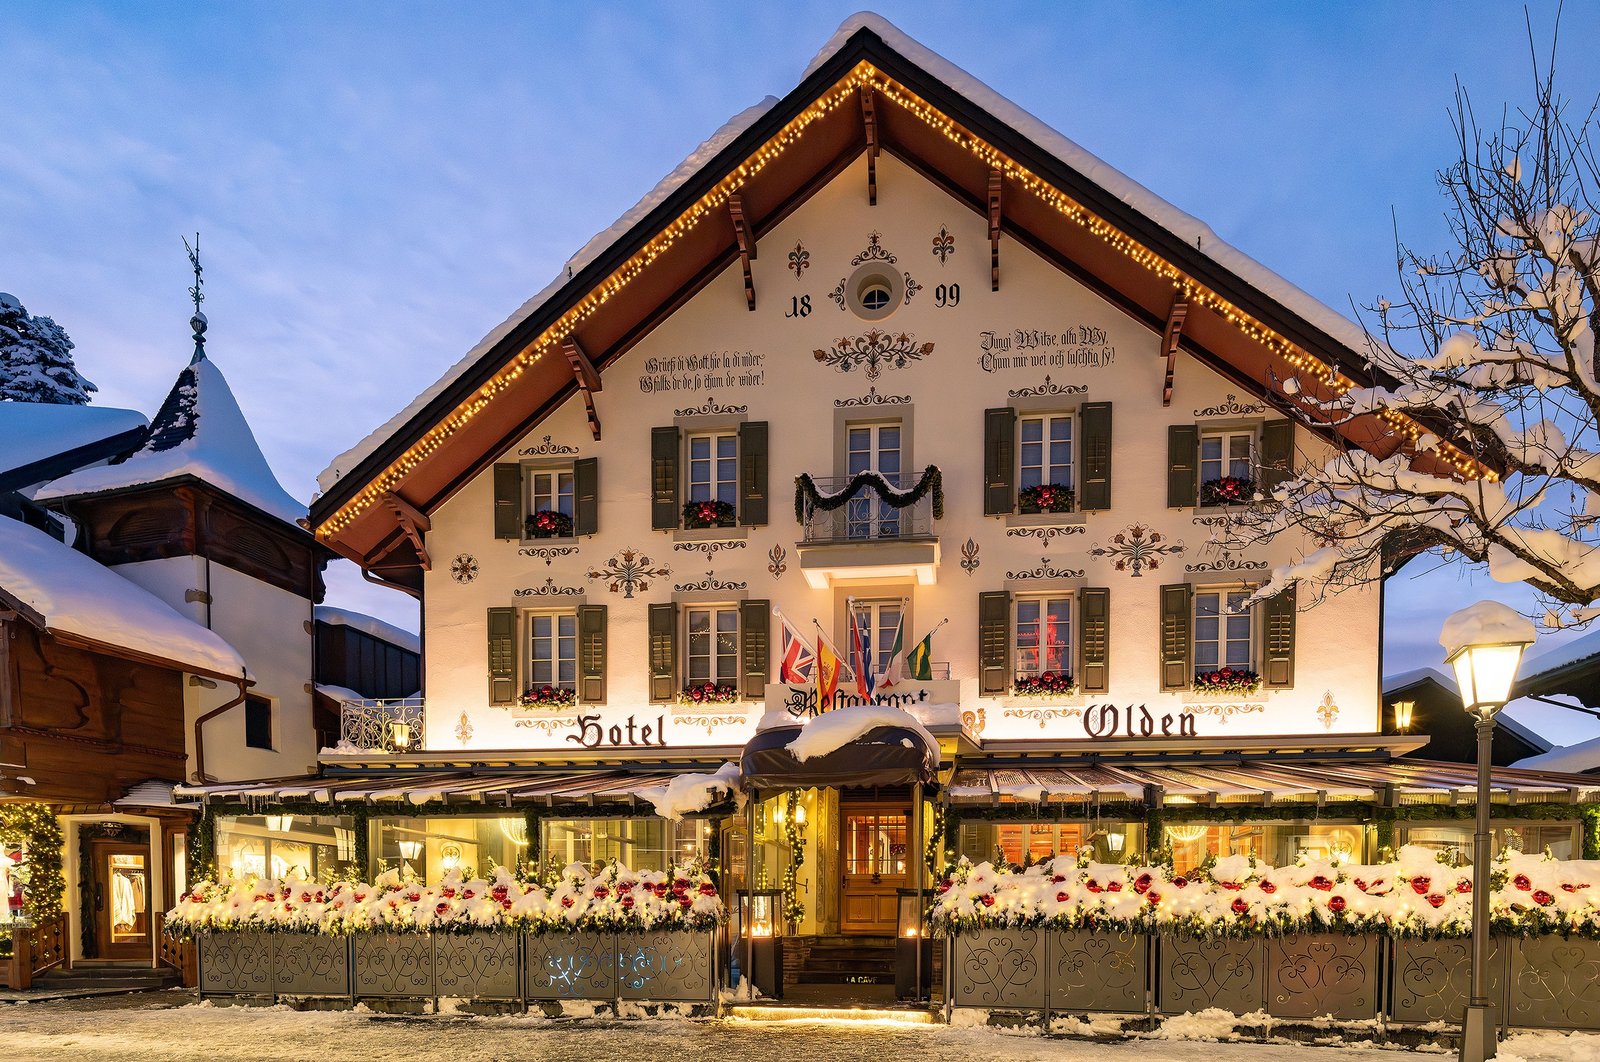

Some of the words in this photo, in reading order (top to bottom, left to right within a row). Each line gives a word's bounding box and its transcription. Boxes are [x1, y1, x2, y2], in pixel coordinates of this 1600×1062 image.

[785, 294, 812, 318] 18
[935, 283, 961, 308] 99
[566, 714, 667, 748] Hotel
[1083, 703, 1198, 738] Olden
